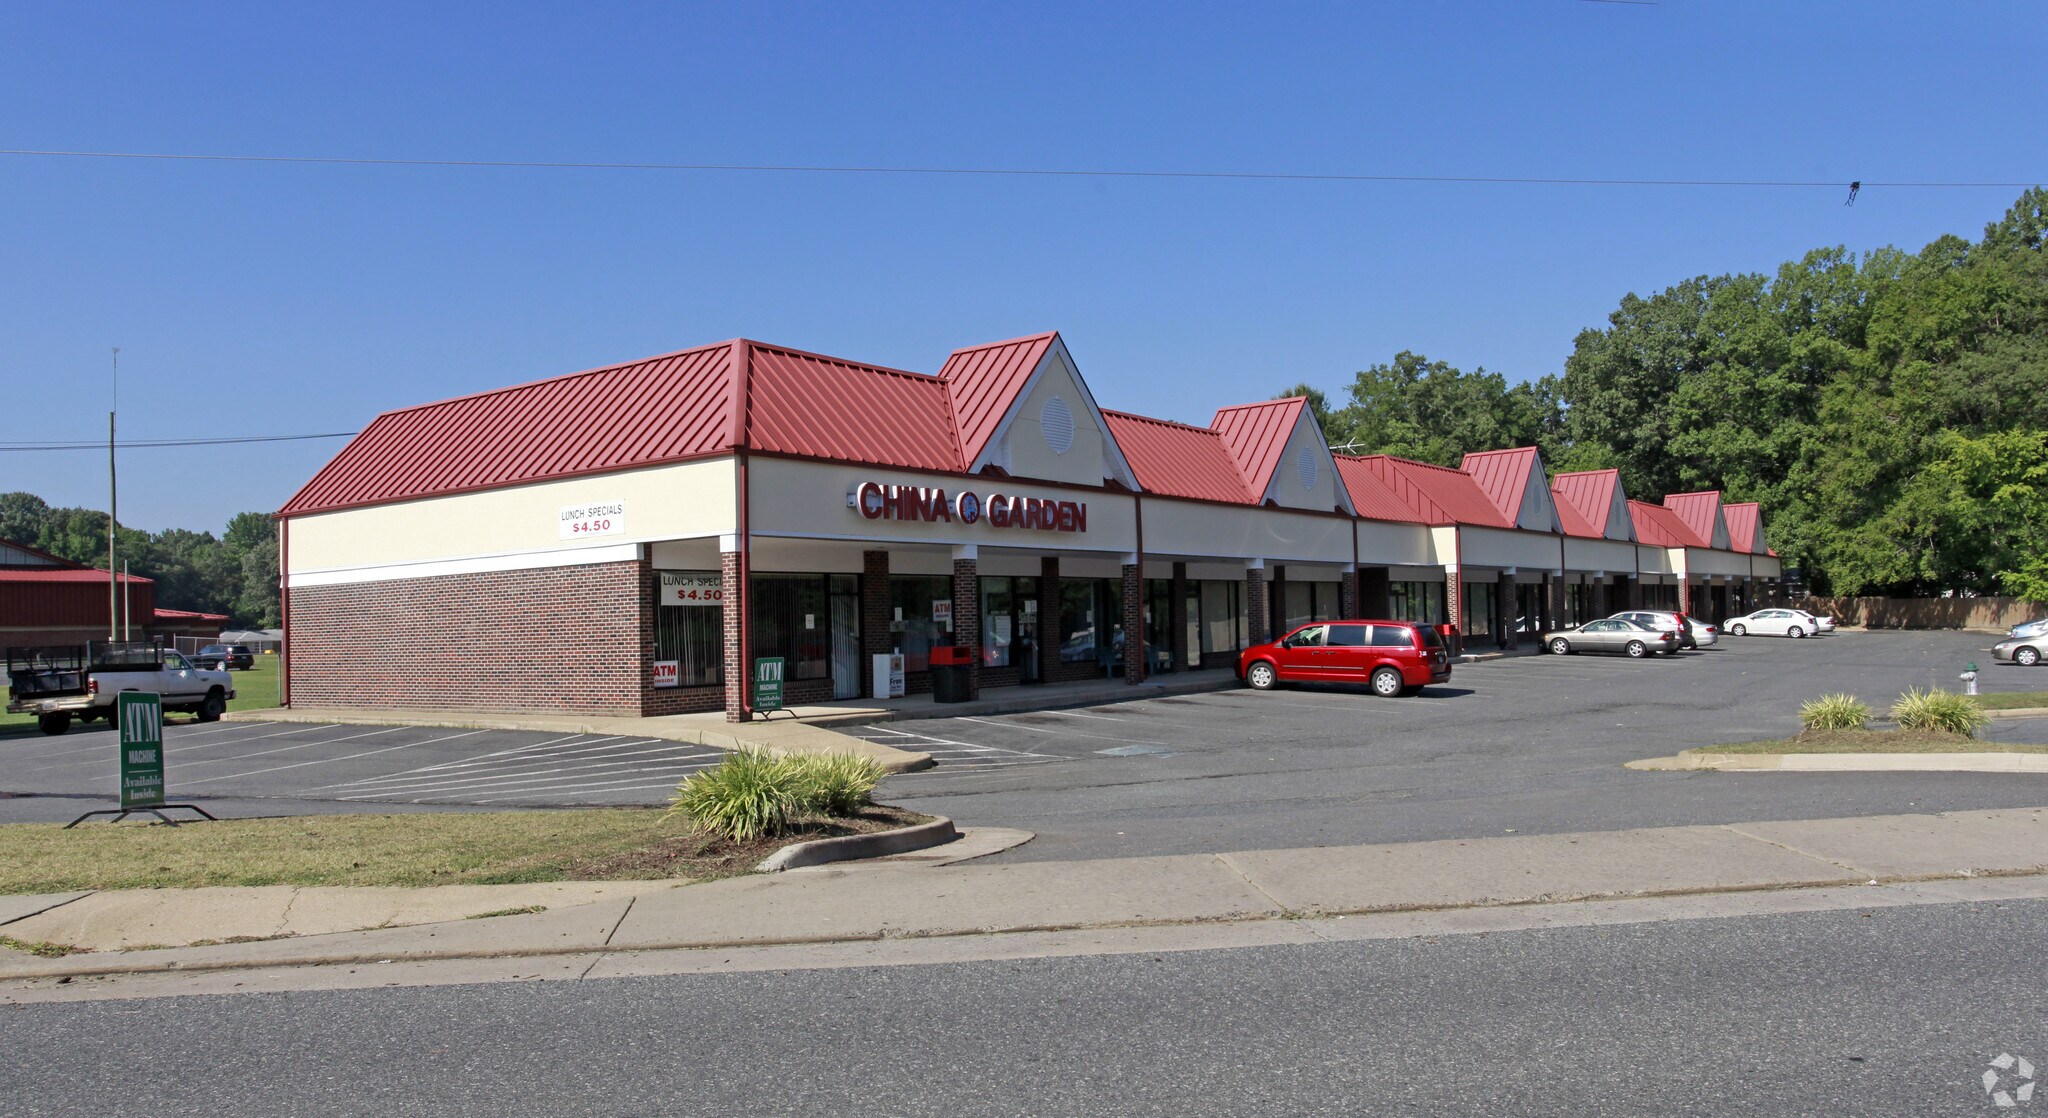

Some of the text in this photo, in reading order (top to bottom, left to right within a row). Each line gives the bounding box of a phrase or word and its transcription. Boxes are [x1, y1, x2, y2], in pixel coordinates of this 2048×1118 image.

[561, 504, 623, 521] LUNCH SPECIALS
[857, 481, 1087, 533] CHINA GARDEN
[573, 519, 611, 533] $4.50
[663, 576, 723, 587] LUNCH SPECI
[677, 589, 723, 601] $4.50
[934, 603, 951, 613] ATM
[653, 665, 676, 677] ATM
[757, 662, 782, 681] ATM
[889, 678, 903, 686] Free
[123, 702, 160, 742] ATM
[128, 749, 156, 764] MACHINE
[123, 775, 162, 788] Available
[130, 788, 156, 800] Inside
